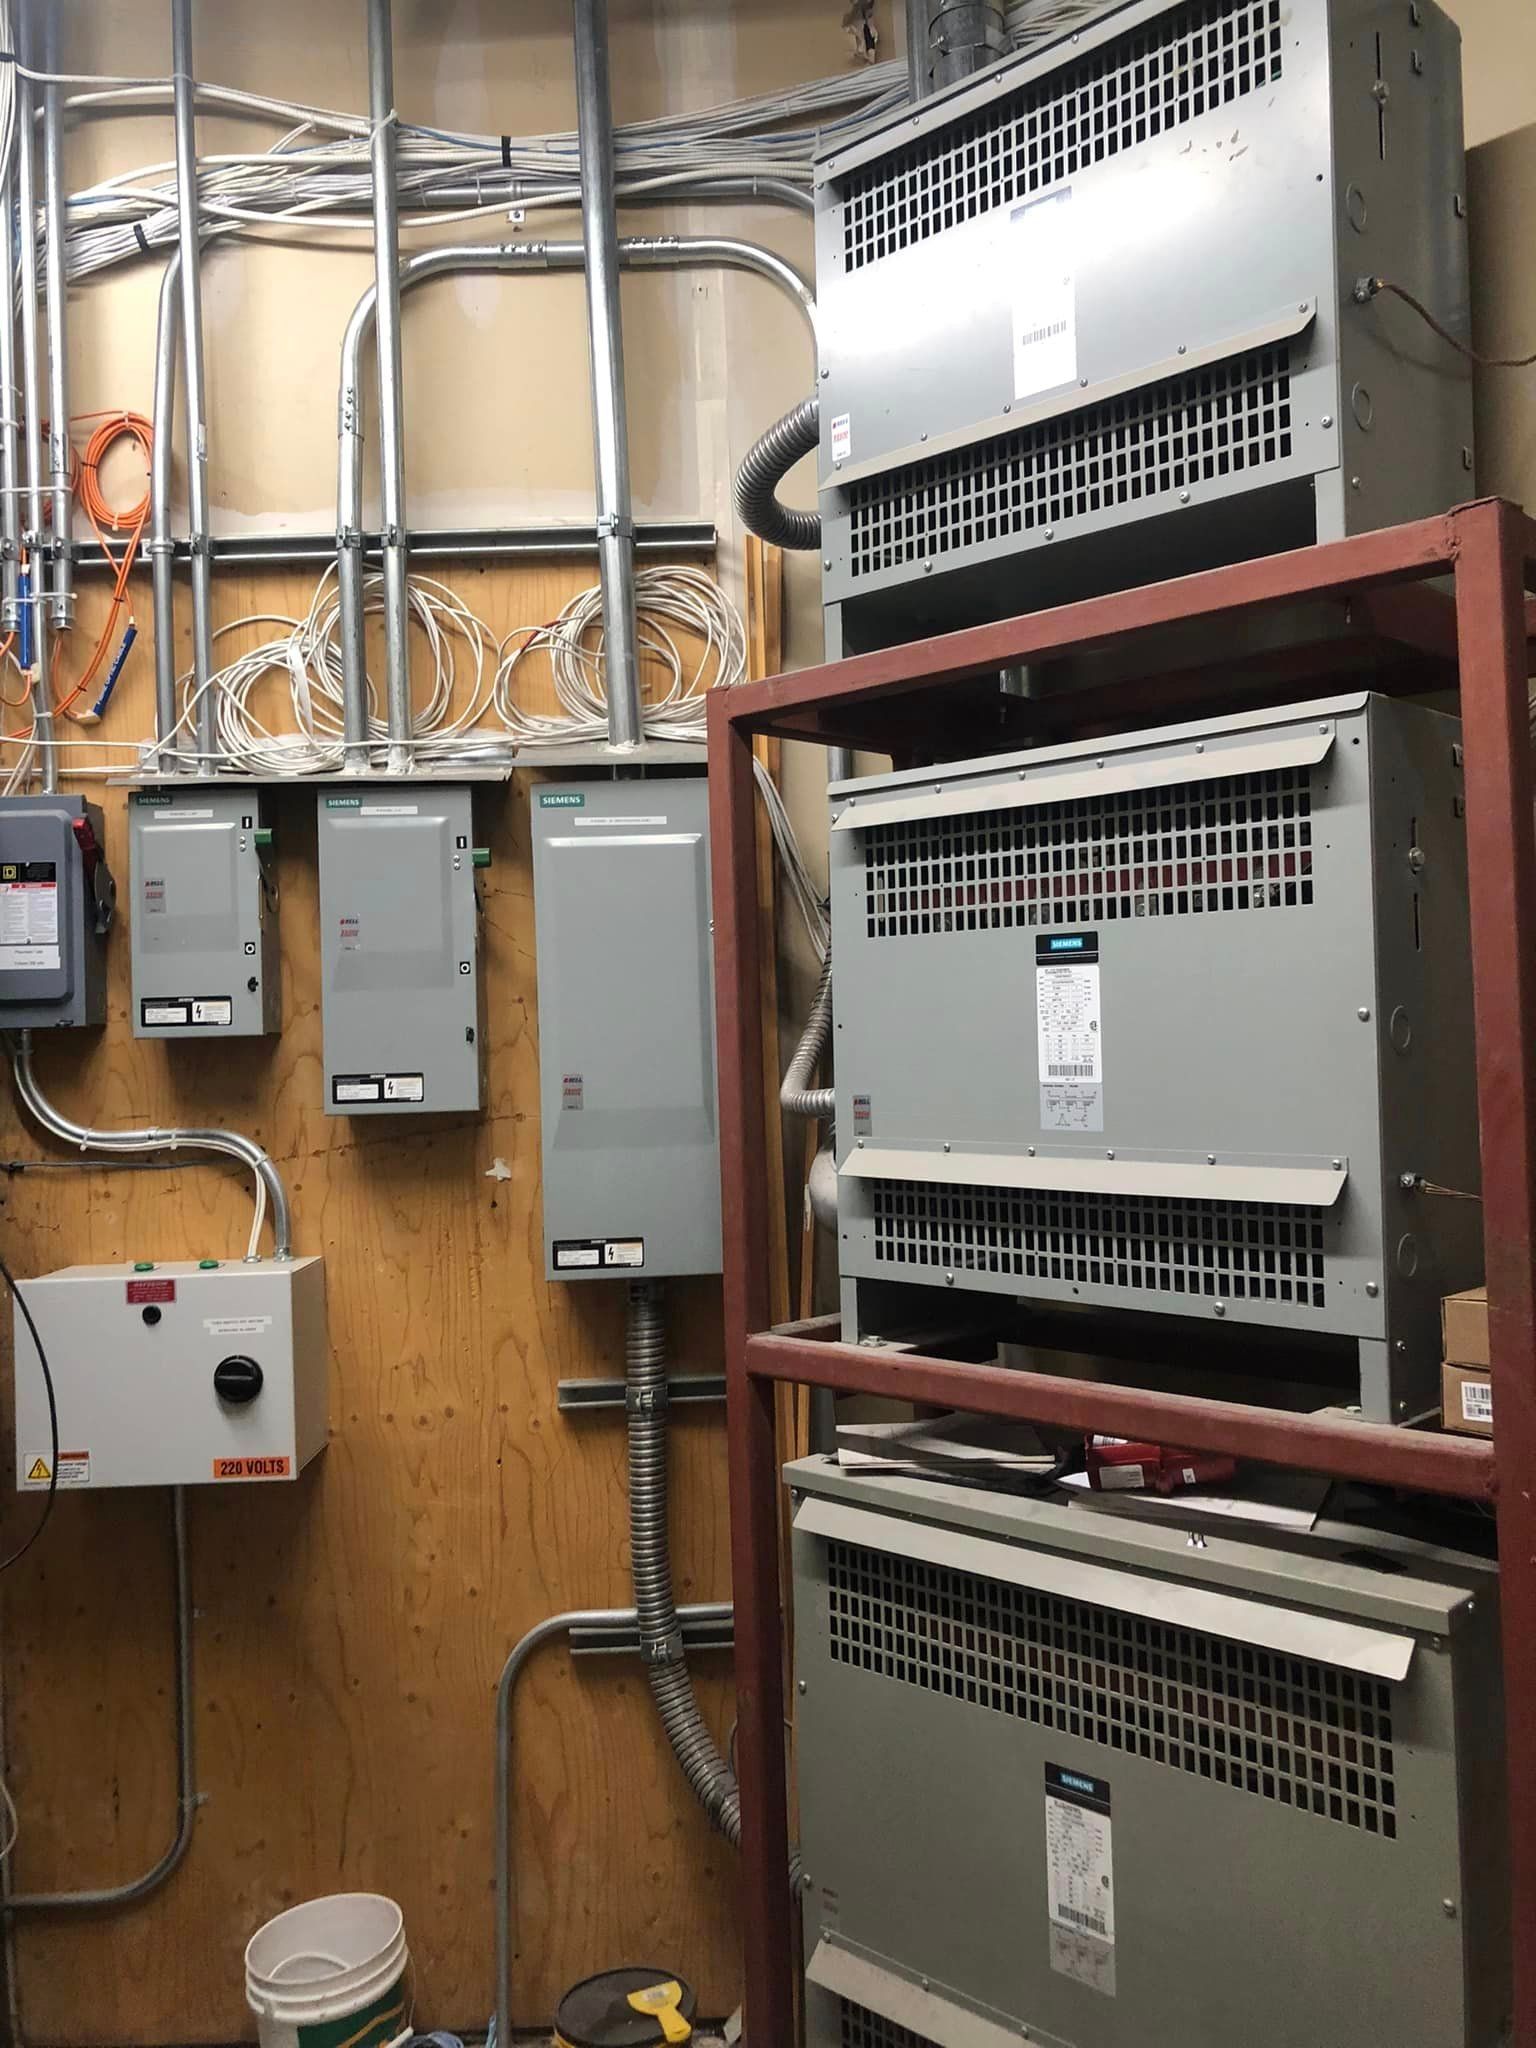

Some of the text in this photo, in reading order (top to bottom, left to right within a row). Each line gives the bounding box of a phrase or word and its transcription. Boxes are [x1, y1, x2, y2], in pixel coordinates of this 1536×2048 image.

[328, 799, 360, 807] SIEMENS
[542, 796, 581, 805] SIEMENS
[1050, 937, 1083, 950] SIEMENS
[220, 1459, 284, 1475] 220 VOLTS
